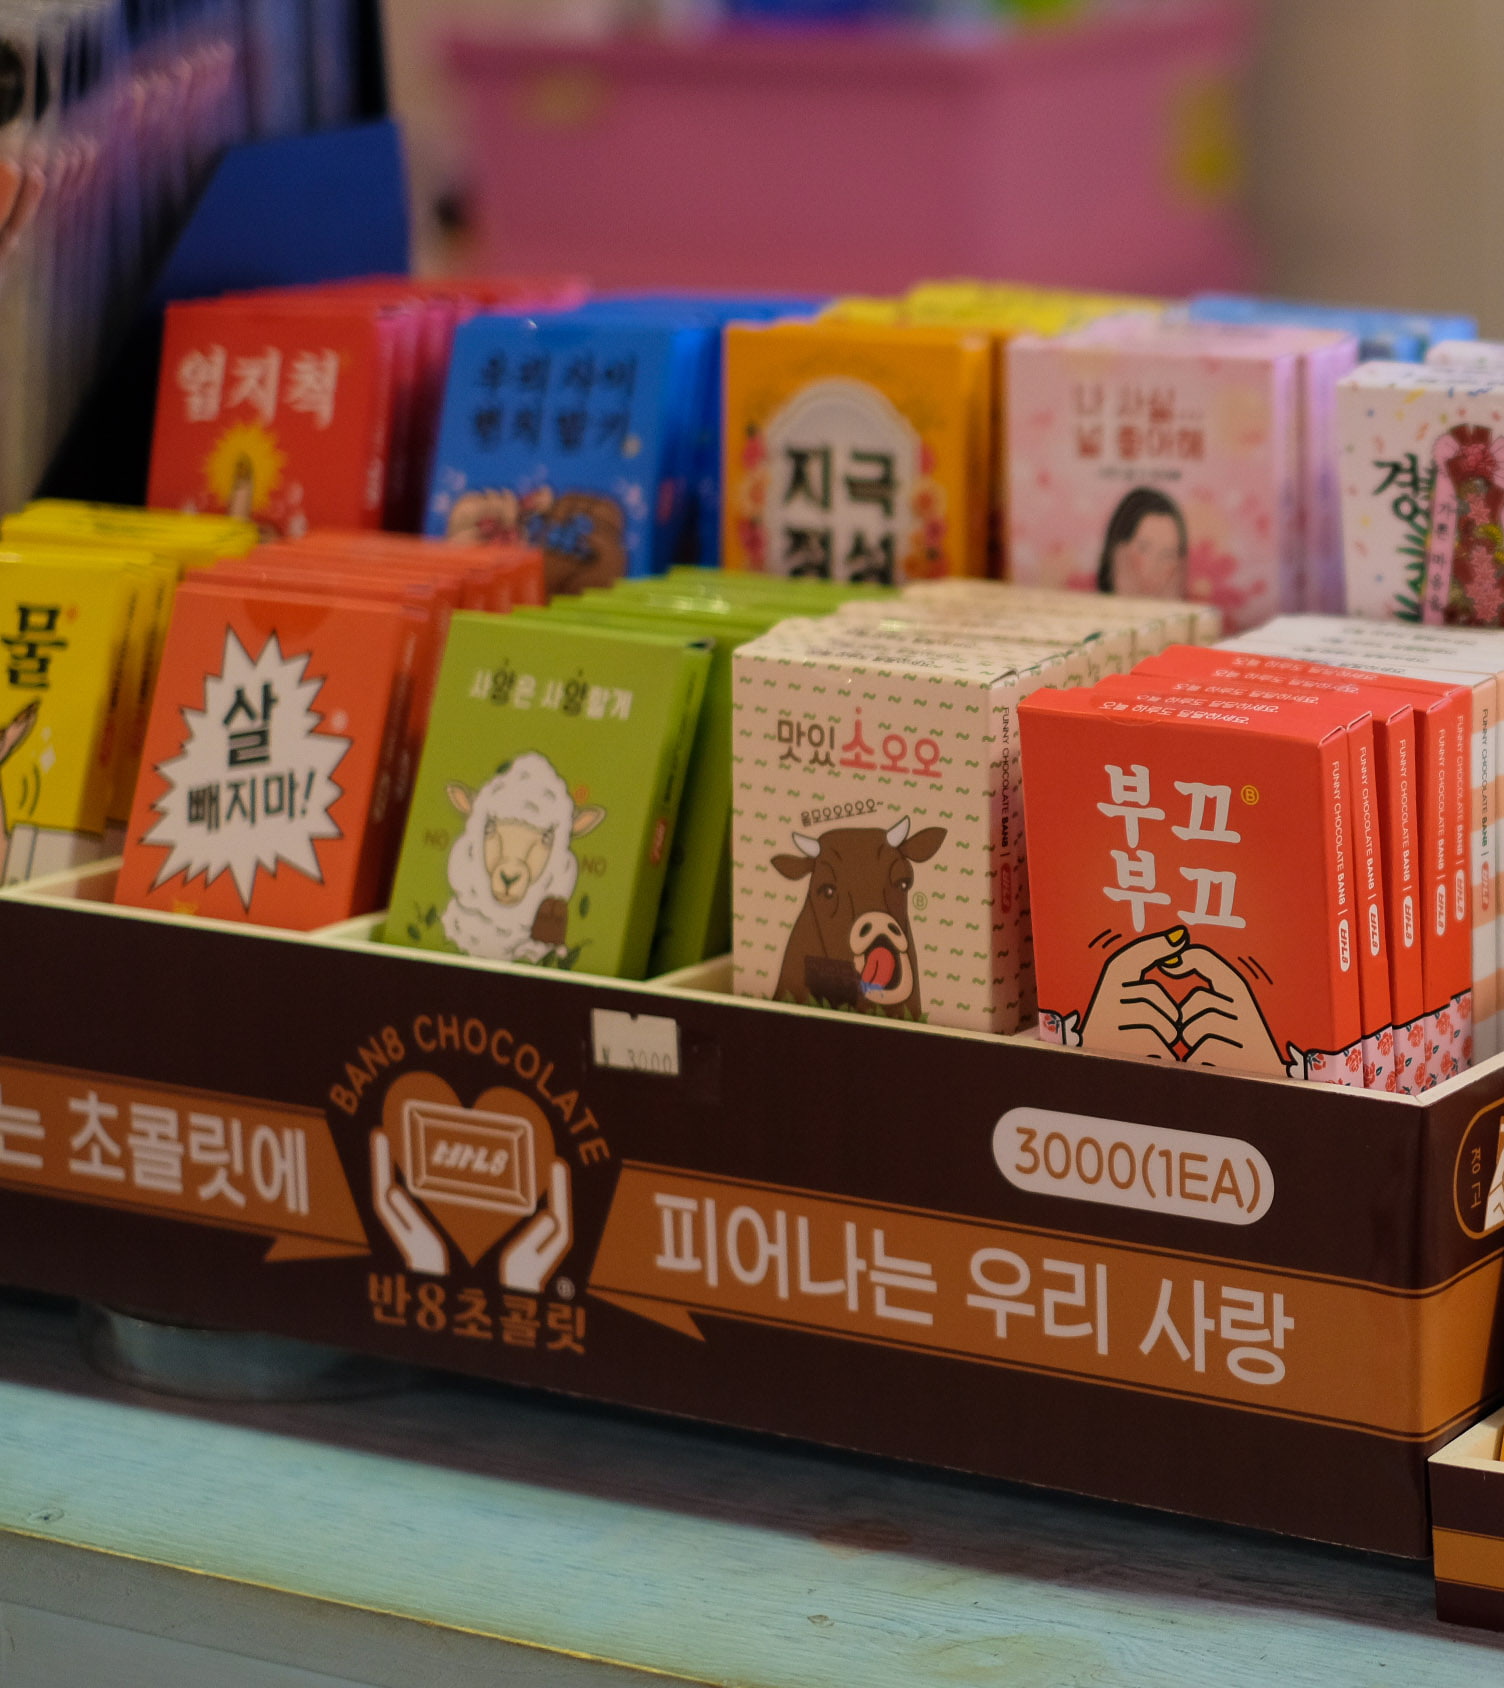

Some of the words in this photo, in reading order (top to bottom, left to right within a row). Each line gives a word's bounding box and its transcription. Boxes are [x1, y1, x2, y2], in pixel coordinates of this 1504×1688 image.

[175, 343, 341, 430] 엄지척
[783, 444, 896, 518] 지극
[221, 683, 279, 768] 살
[776, 706, 943, 779] 맛있소오오
[186, 770, 315, 834] 빼지마!
[1096, 763, 1241, 848] 부끄
[1333, 803, 1345, 871] CHOCOLATE
[1362, 788, 1373, 856] CHOCOLATE
[1400, 780, 1410, 848] CHOCOLATE
[581, 855, 607, 876] NO
[1101, 848, 1247, 933] 부끄
[329, 1025, 406, 1116] BAN8
[412, 1014, 610, 1167] CHOCOLATE
[68, 1090, 310, 1216] 초콜릿에
[1014, 1125, 1262, 1214] 3000(1EA)
[368, 1273, 587, 1356] 반8초콜릿
[653, 1191, 938, 1326] 피어나는
[965, 1246, 1110, 1356] 우리
[1138, 1277, 1295, 1385] 사랑
